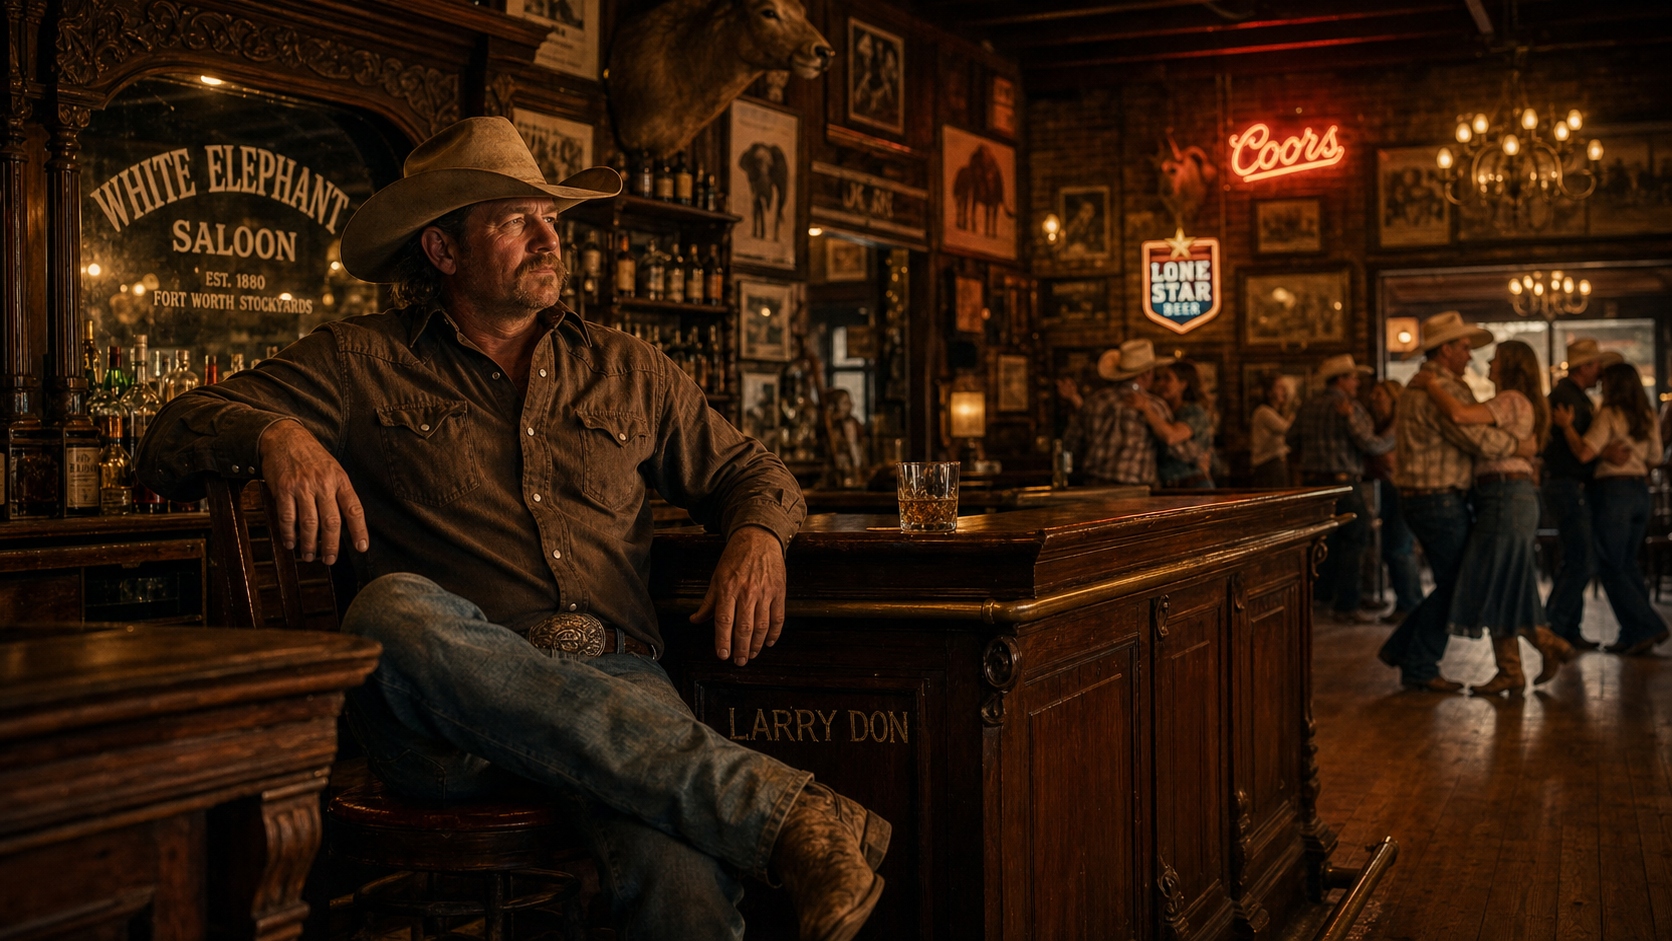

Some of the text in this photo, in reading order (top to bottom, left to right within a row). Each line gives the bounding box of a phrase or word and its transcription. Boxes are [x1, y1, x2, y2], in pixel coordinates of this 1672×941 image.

[1229, 123, 1345, 182] Coors
[89, 144, 350, 235] WHITE ELEPHANT
[172, 219, 297, 262] SALOON
[205, 271, 266, 290] EST. 1880
[1151, 260, 1211, 283] LONE
[153, 290, 313, 315] FORT WORTH STOCKYARDS
[1151, 281, 1212, 304] STAR
[1163, 301, 1201, 317] BEER
[728, 707, 909, 744] LARRY DON
